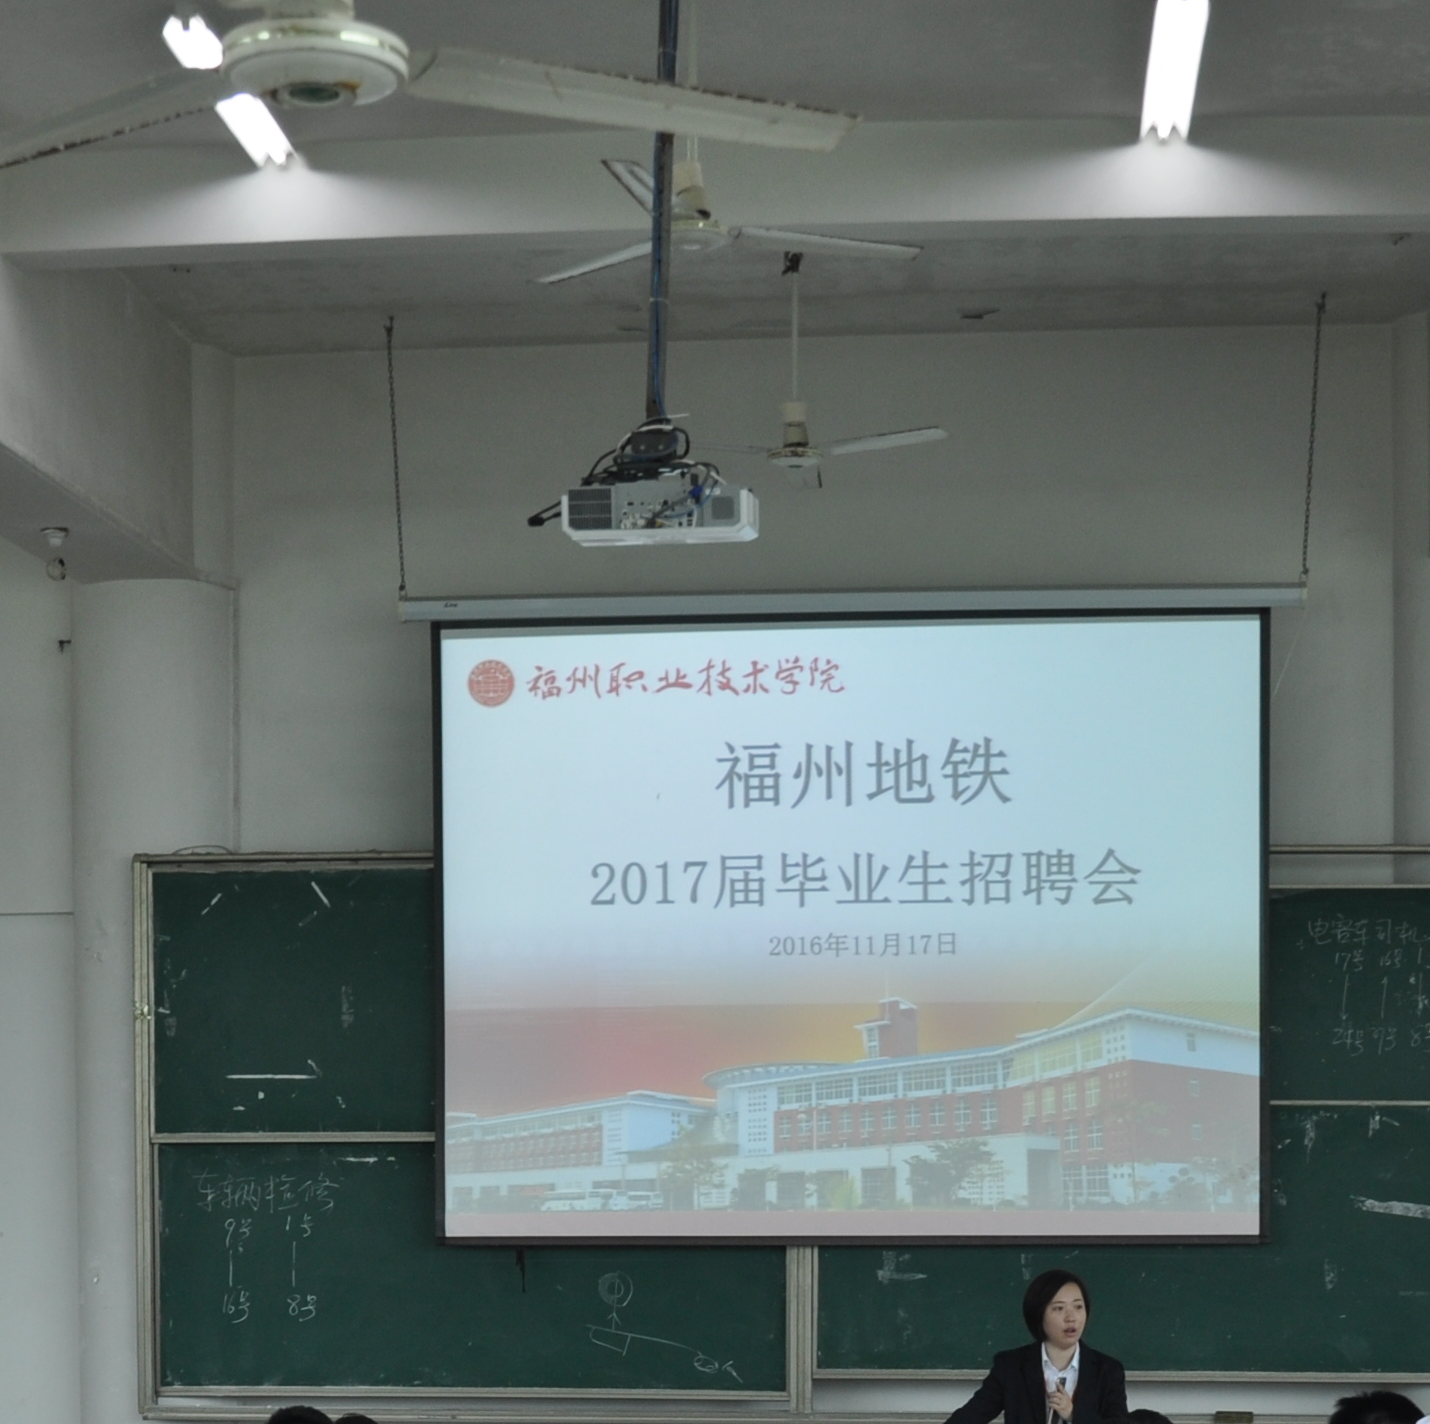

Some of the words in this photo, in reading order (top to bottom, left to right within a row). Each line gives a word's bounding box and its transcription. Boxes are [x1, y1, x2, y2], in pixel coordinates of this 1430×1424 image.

[526, 655, 846, 700] 福州职业技术学院
[714, 737, 1013, 811] 福州地铁
[590, 847, 1143, 912] 2017届毕业生招聘会
[768, 930, 959, 959] 2016年11月17日
[192, 1168, 341, 1214] 车辆检修
[224, 1218, 252, 1248] 9号
[222, 1291, 251, 1323] 16号
[287, 1294, 317, 1322] 8号
